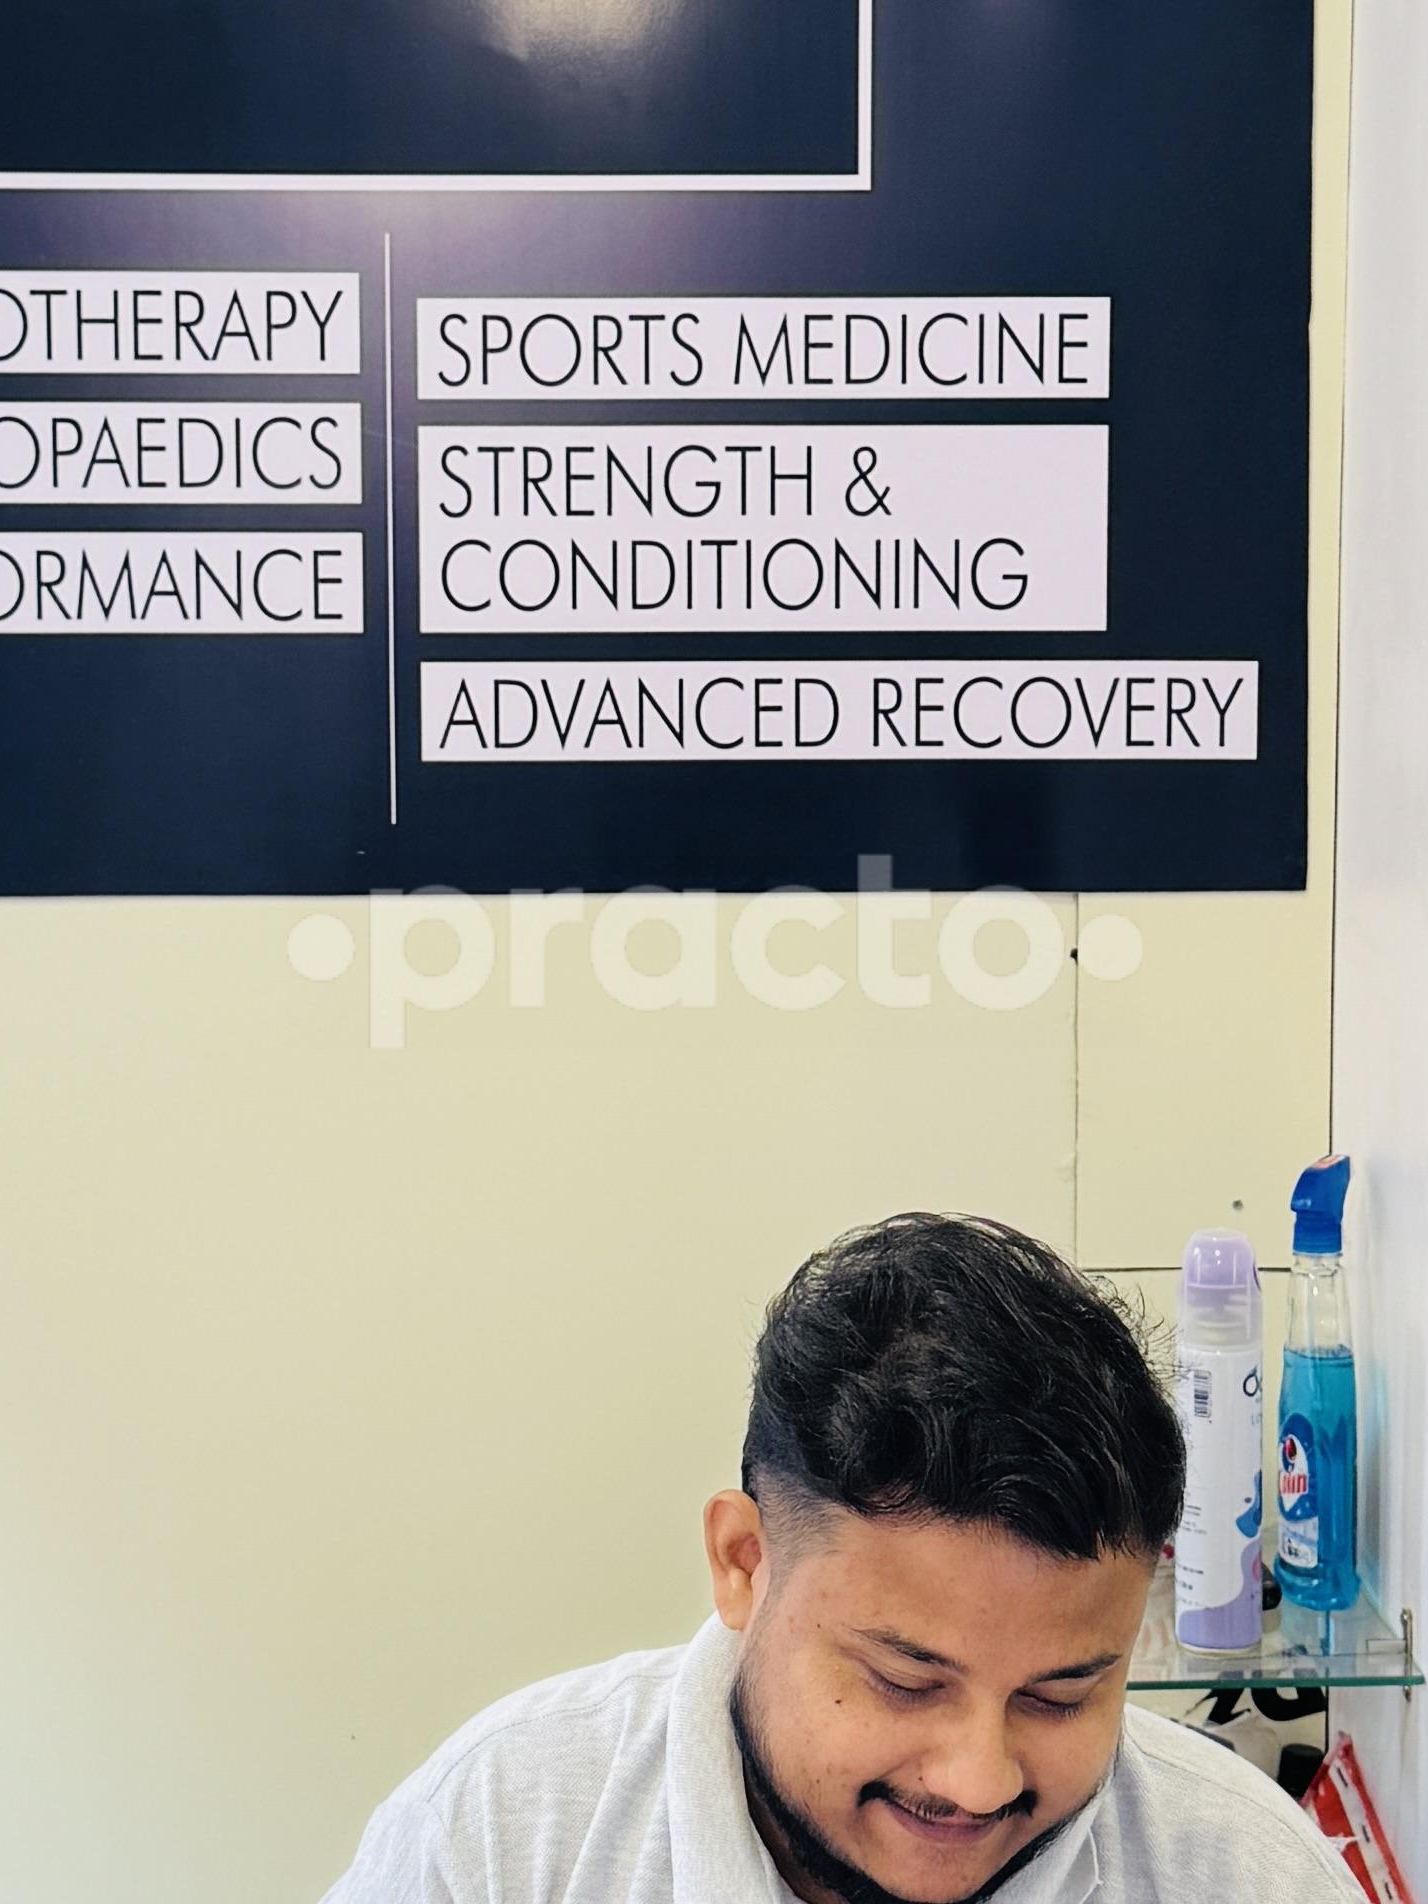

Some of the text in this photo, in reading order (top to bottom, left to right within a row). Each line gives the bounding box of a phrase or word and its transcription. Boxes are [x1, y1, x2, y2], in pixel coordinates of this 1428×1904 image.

[439, 313, 1088, 386] SPORTS MEDICINE
[440, 445, 891, 518] STRENGTH &
[442, 538, 1028, 611] CONDITIONING
[440, 677, 1243, 749] ADVANCED RECOVERY
